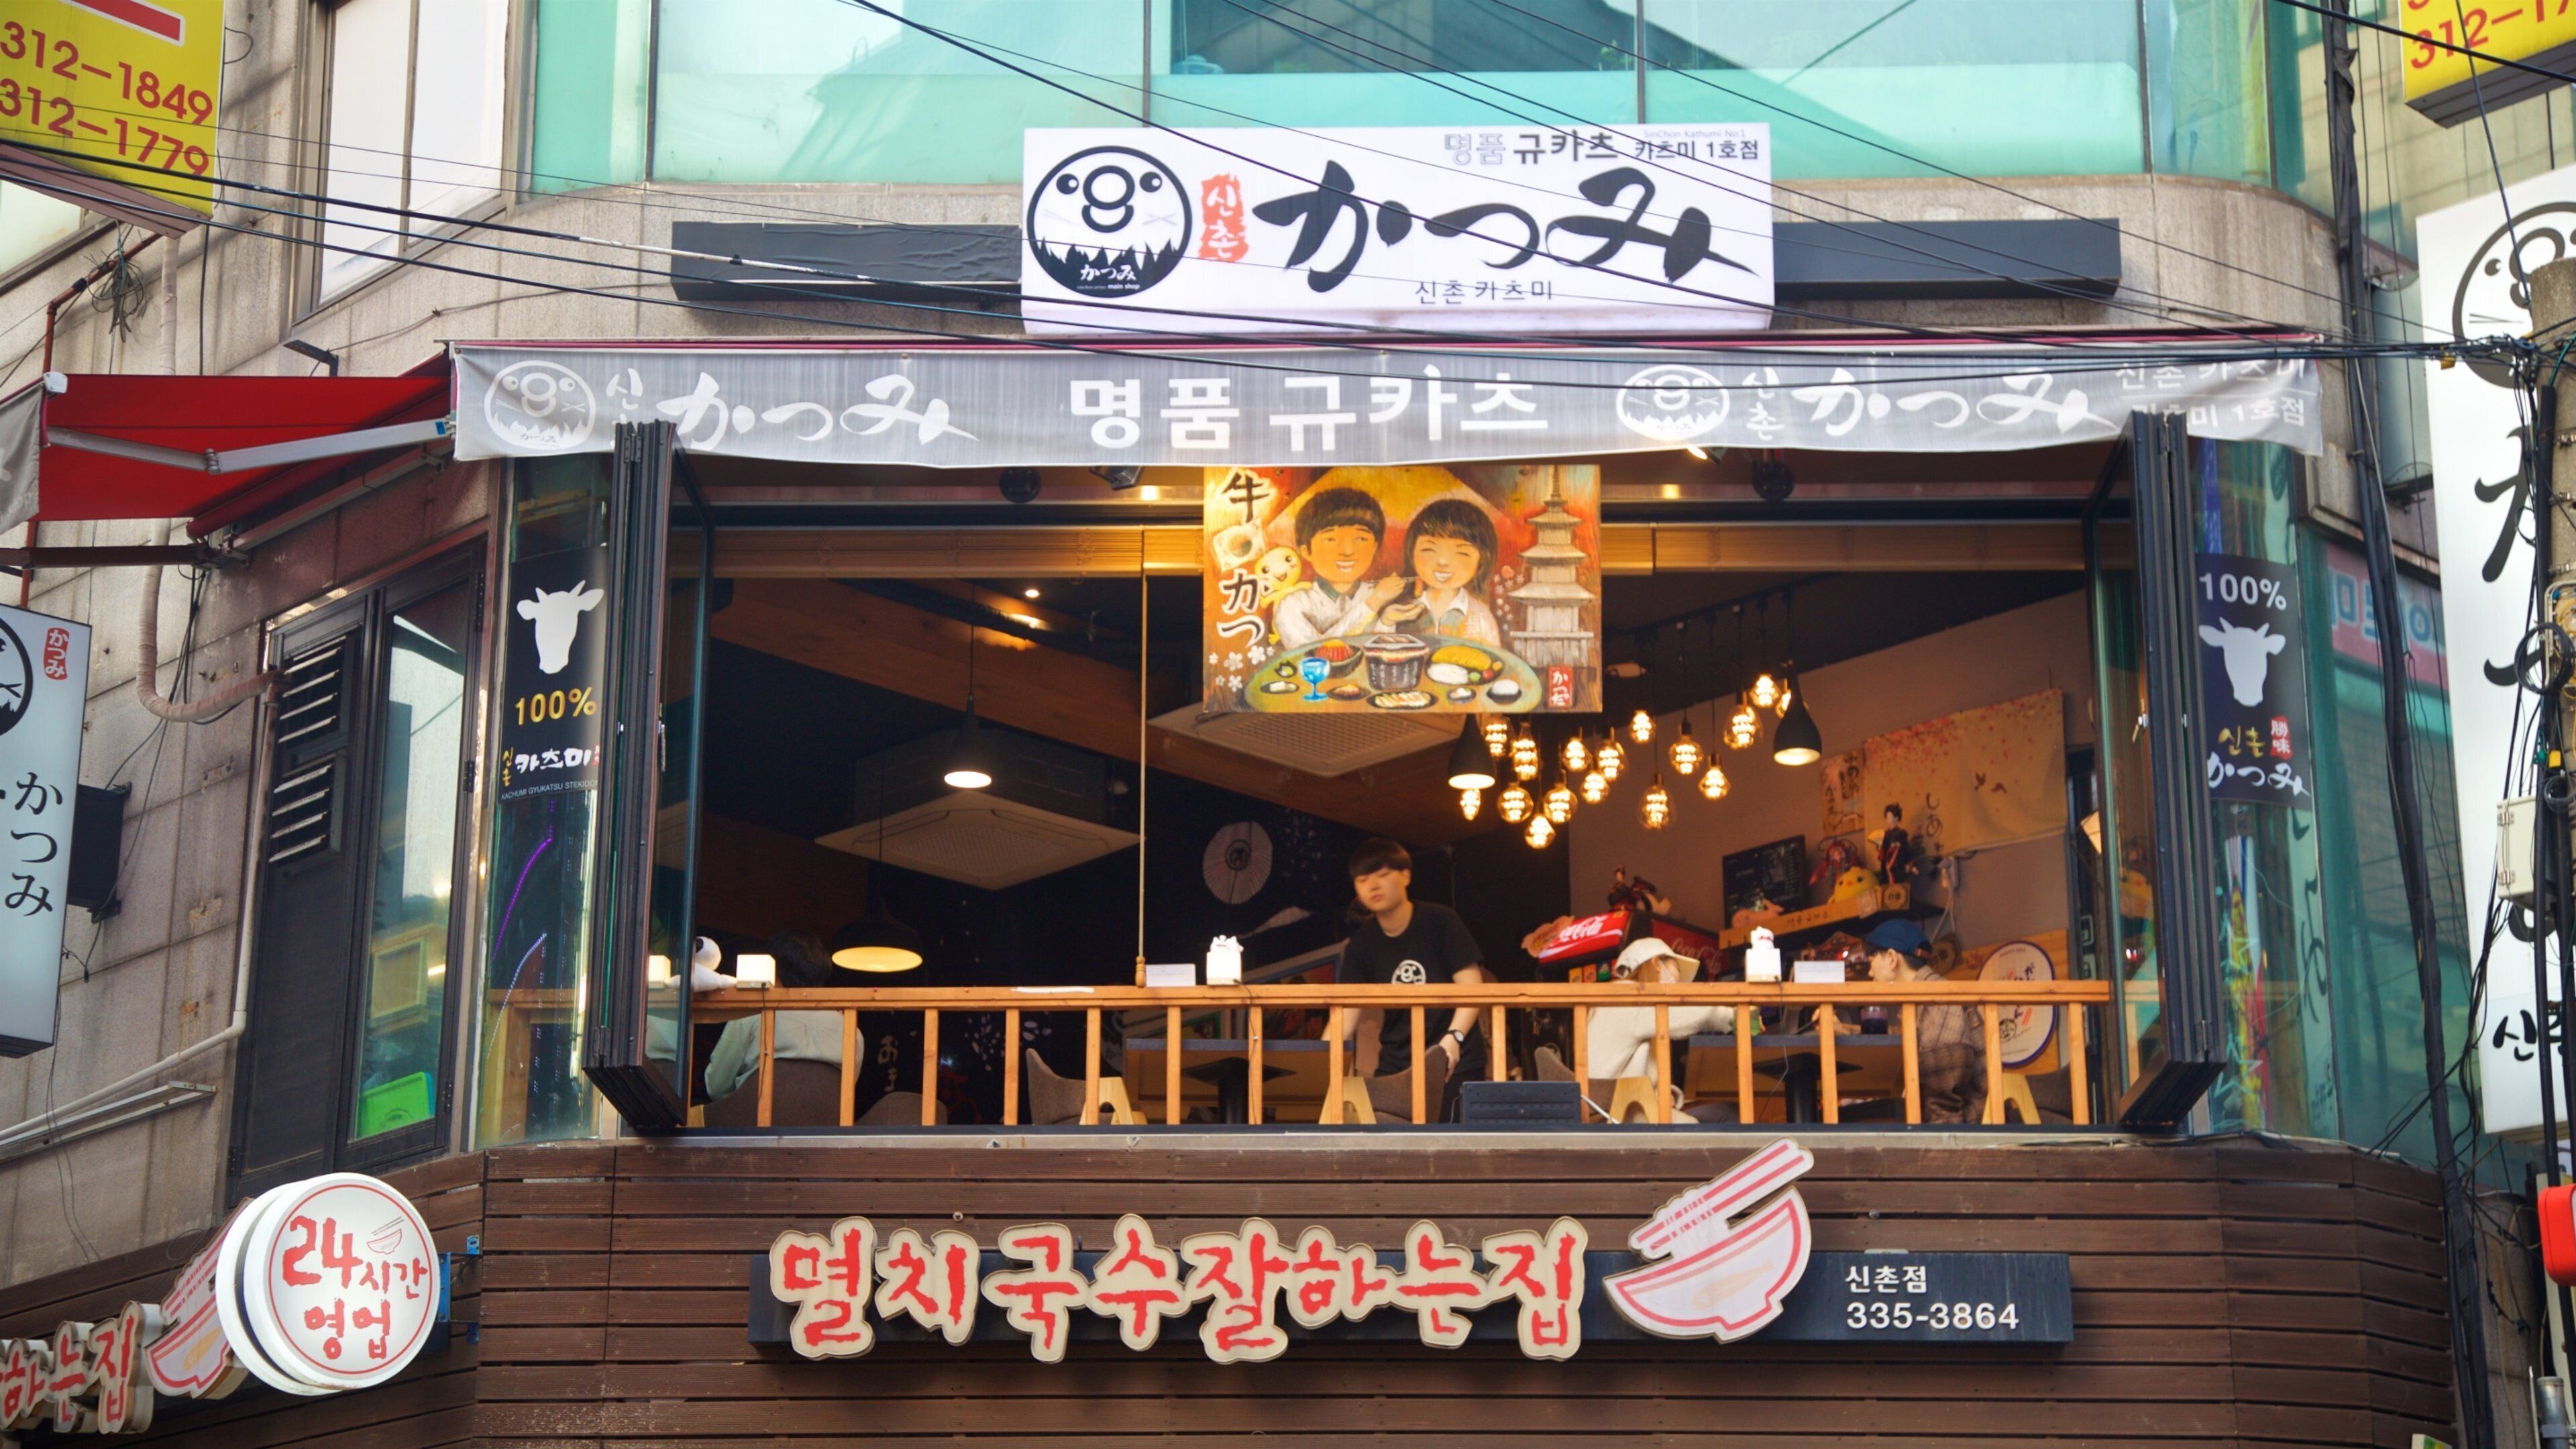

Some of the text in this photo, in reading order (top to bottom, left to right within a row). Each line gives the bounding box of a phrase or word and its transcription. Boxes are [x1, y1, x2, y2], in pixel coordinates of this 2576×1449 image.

[0, 21, 213, 126] 312-1849
[0, 78, 210, 176] 312-1779
[1444, 129, 1619, 166] 명품 규카츠
[1635, 139, 1759, 161] 카츠미 1호점
[1207, 186, 1240, 259] 신촌
[1252, 159, 1763, 293] かつみ
[1080, 263, 1138, 282] かつみ
[1415, 280, 1553, 305] 신촌 카츠미
[655, 371, 981, 451] かつみ
[1070, 364, 1549, 452] 명품 규카츠
[1742, 367, 1786, 441] 신촌
[1790, 366, 2121, 437] かつみ
[2231, 397, 2306, 427] 1호점
[2199, 572, 2288, 611] 100%
[47, 629, 69, 680] かつみ
[515, 686, 598, 727] 100%
[515, 747, 592, 774] 카츠미
[2218, 724, 2266, 759] 신촌
[501, 788, 527, 801] KACHUMI
[528, 782, 564, 795] GYUKATSU
[2206, 751, 2311, 797] かつみ
[5, 771, 63, 917] かつみ
[281, 1215, 429, 1300] 24시간
[1845, 1265, 1927, 1294] 신촌점
[783, 1227, 1577, 1351] 멸치국수잘하는집
[304, 1297, 391, 1360] 영업
[1846, 1302, 2020, 1330] 335-3864
[2, 1313, 135, 1423] 하는집
